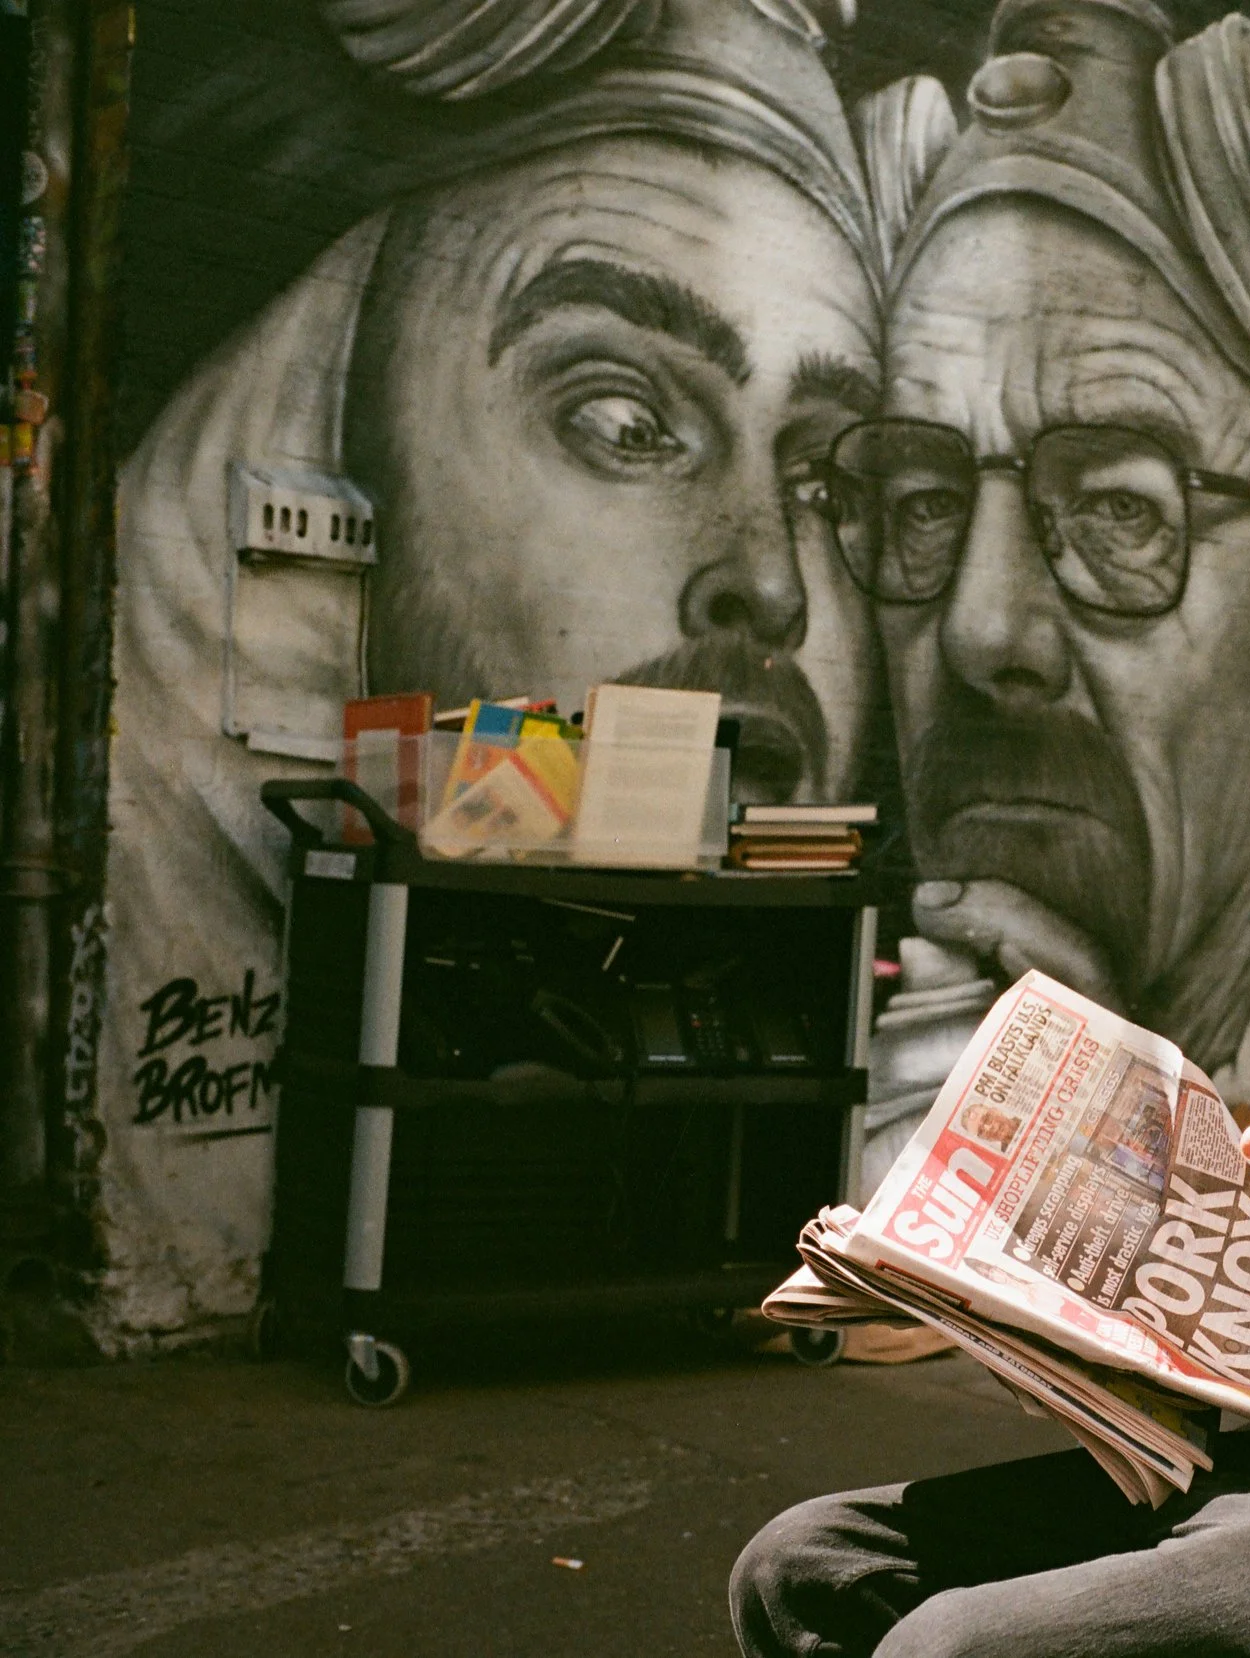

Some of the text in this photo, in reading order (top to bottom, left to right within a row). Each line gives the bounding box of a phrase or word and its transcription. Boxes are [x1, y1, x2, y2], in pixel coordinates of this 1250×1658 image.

[974, 1000, 1041, 1098] PM BLASTS U.S.
[989, 1078, 1011, 1104] ON
[1001, 1005, 1053, 1090] FALKLANDS
[911, 1174, 933, 1201] THE
[983, 1216, 1003, 1241] UK
[994, 1104, 1066, 1224] SHOPLIFTING
[1056, 1037, 1100, 1107] CRISIS
[893, 1146, 995, 1259] Sun
[1021, 1206, 1051, 1254] Greggs
[1039, 1153, 1084, 1222] scrapping
[1042, 1163, 1109, 1279] self-service displays
[1076, 1186, 1130, 1285] Anti-theft drive
[1092, 1290, 1108, 1308] is
[1100, 1265, 1124, 1299] most
[1112, 1222, 1143, 1273] drastic
[1134, 1201, 1161, 1228] yet
[1121, 1173, 1236, 1349] PORK
[940, 1317, 1053, 1390] FRIDAY AND SATURDAY
